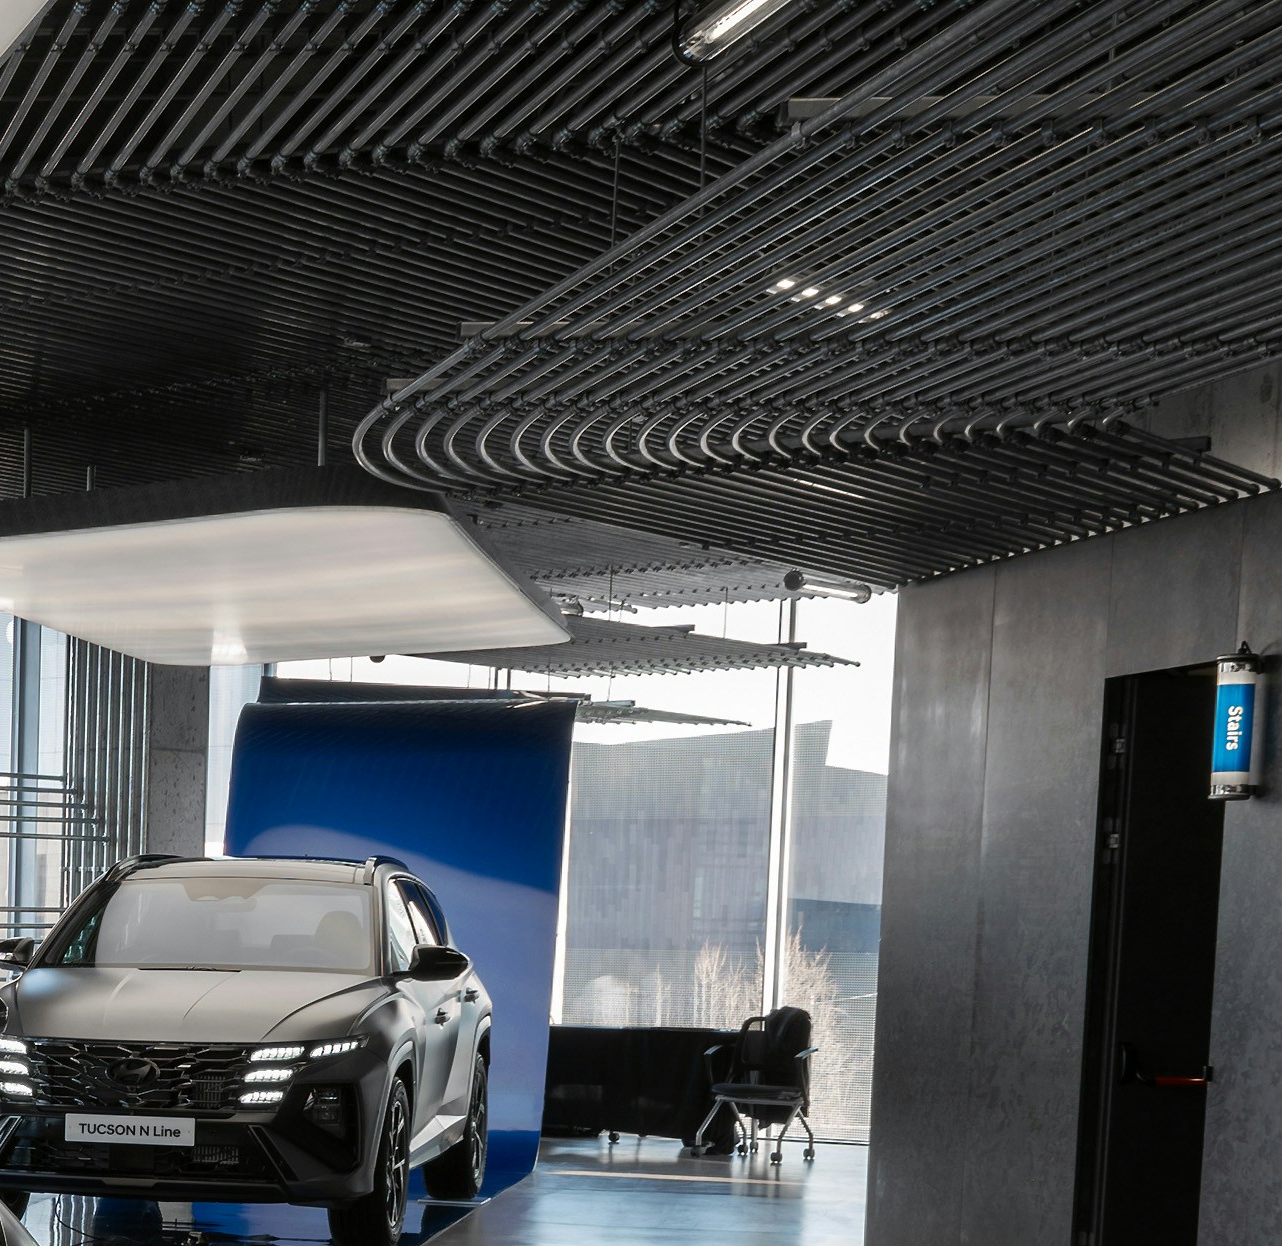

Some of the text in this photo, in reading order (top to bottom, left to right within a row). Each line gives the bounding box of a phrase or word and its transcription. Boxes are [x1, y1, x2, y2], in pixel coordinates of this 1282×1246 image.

[1226, 706, 1243, 750] Stairs
[79, 1123, 181, 1137] TUCSON N Line
